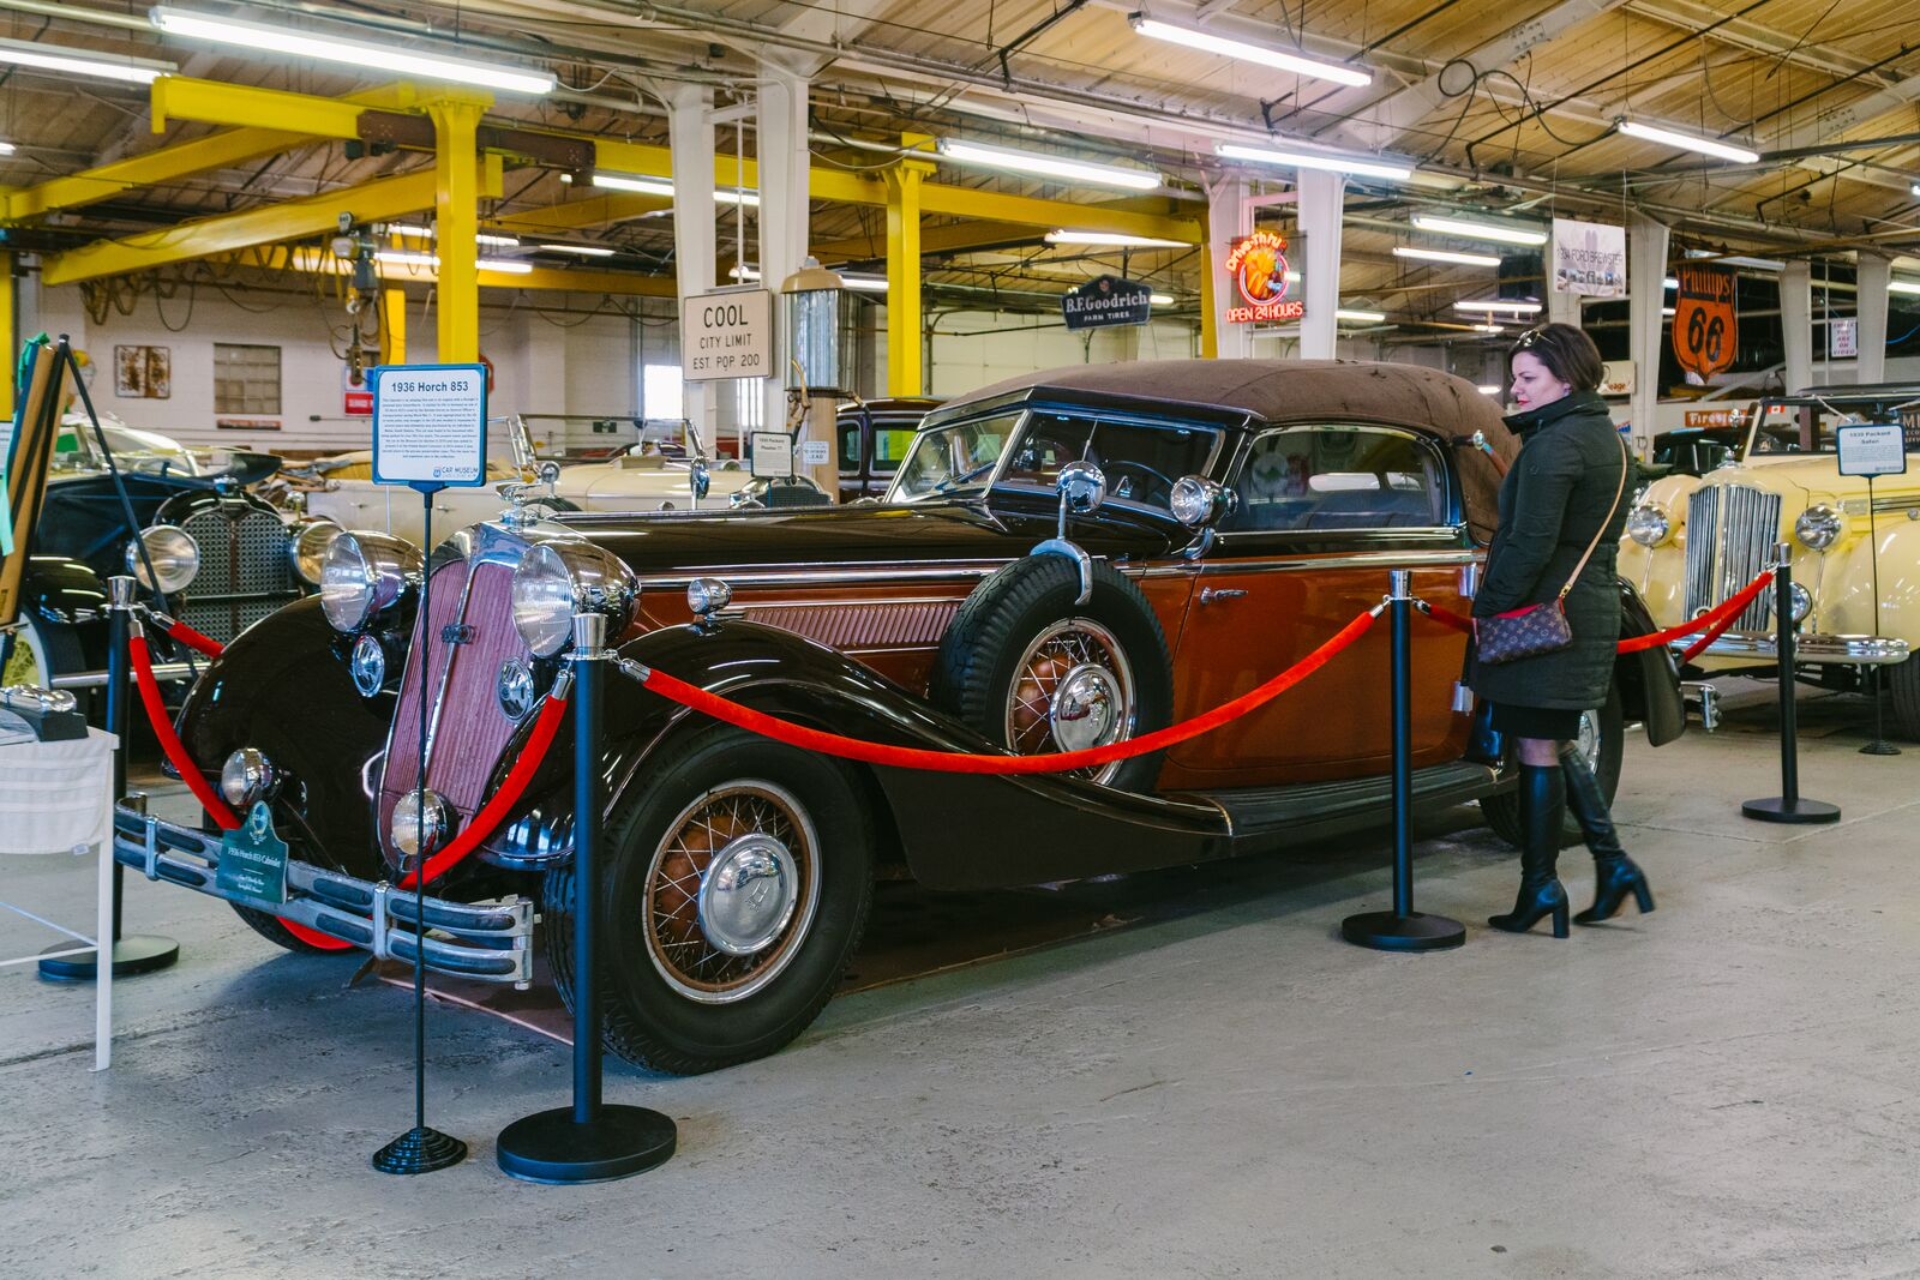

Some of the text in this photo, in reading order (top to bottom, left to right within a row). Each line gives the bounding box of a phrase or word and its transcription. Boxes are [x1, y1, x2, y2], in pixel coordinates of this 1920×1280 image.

[1225, 231, 1283, 272] Drive-Thru
[1572, 248, 1591, 263] FORD
[1682, 267, 1731, 306] Phillips
[703, 304, 749, 328] COOL
[1083, 310, 1131, 322] FARM TIRES
[1226, 300, 1303, 322] OPEN 24 HOURS
[700, 333, 752, 350] CITY LIMIT
[1688, 306, 1725, 363] 66
[740, 353, 760, 367] 200
[391, 381, 469, 393] 1936 Horch 853
[454, 465, 478, 475] MUSEUM
